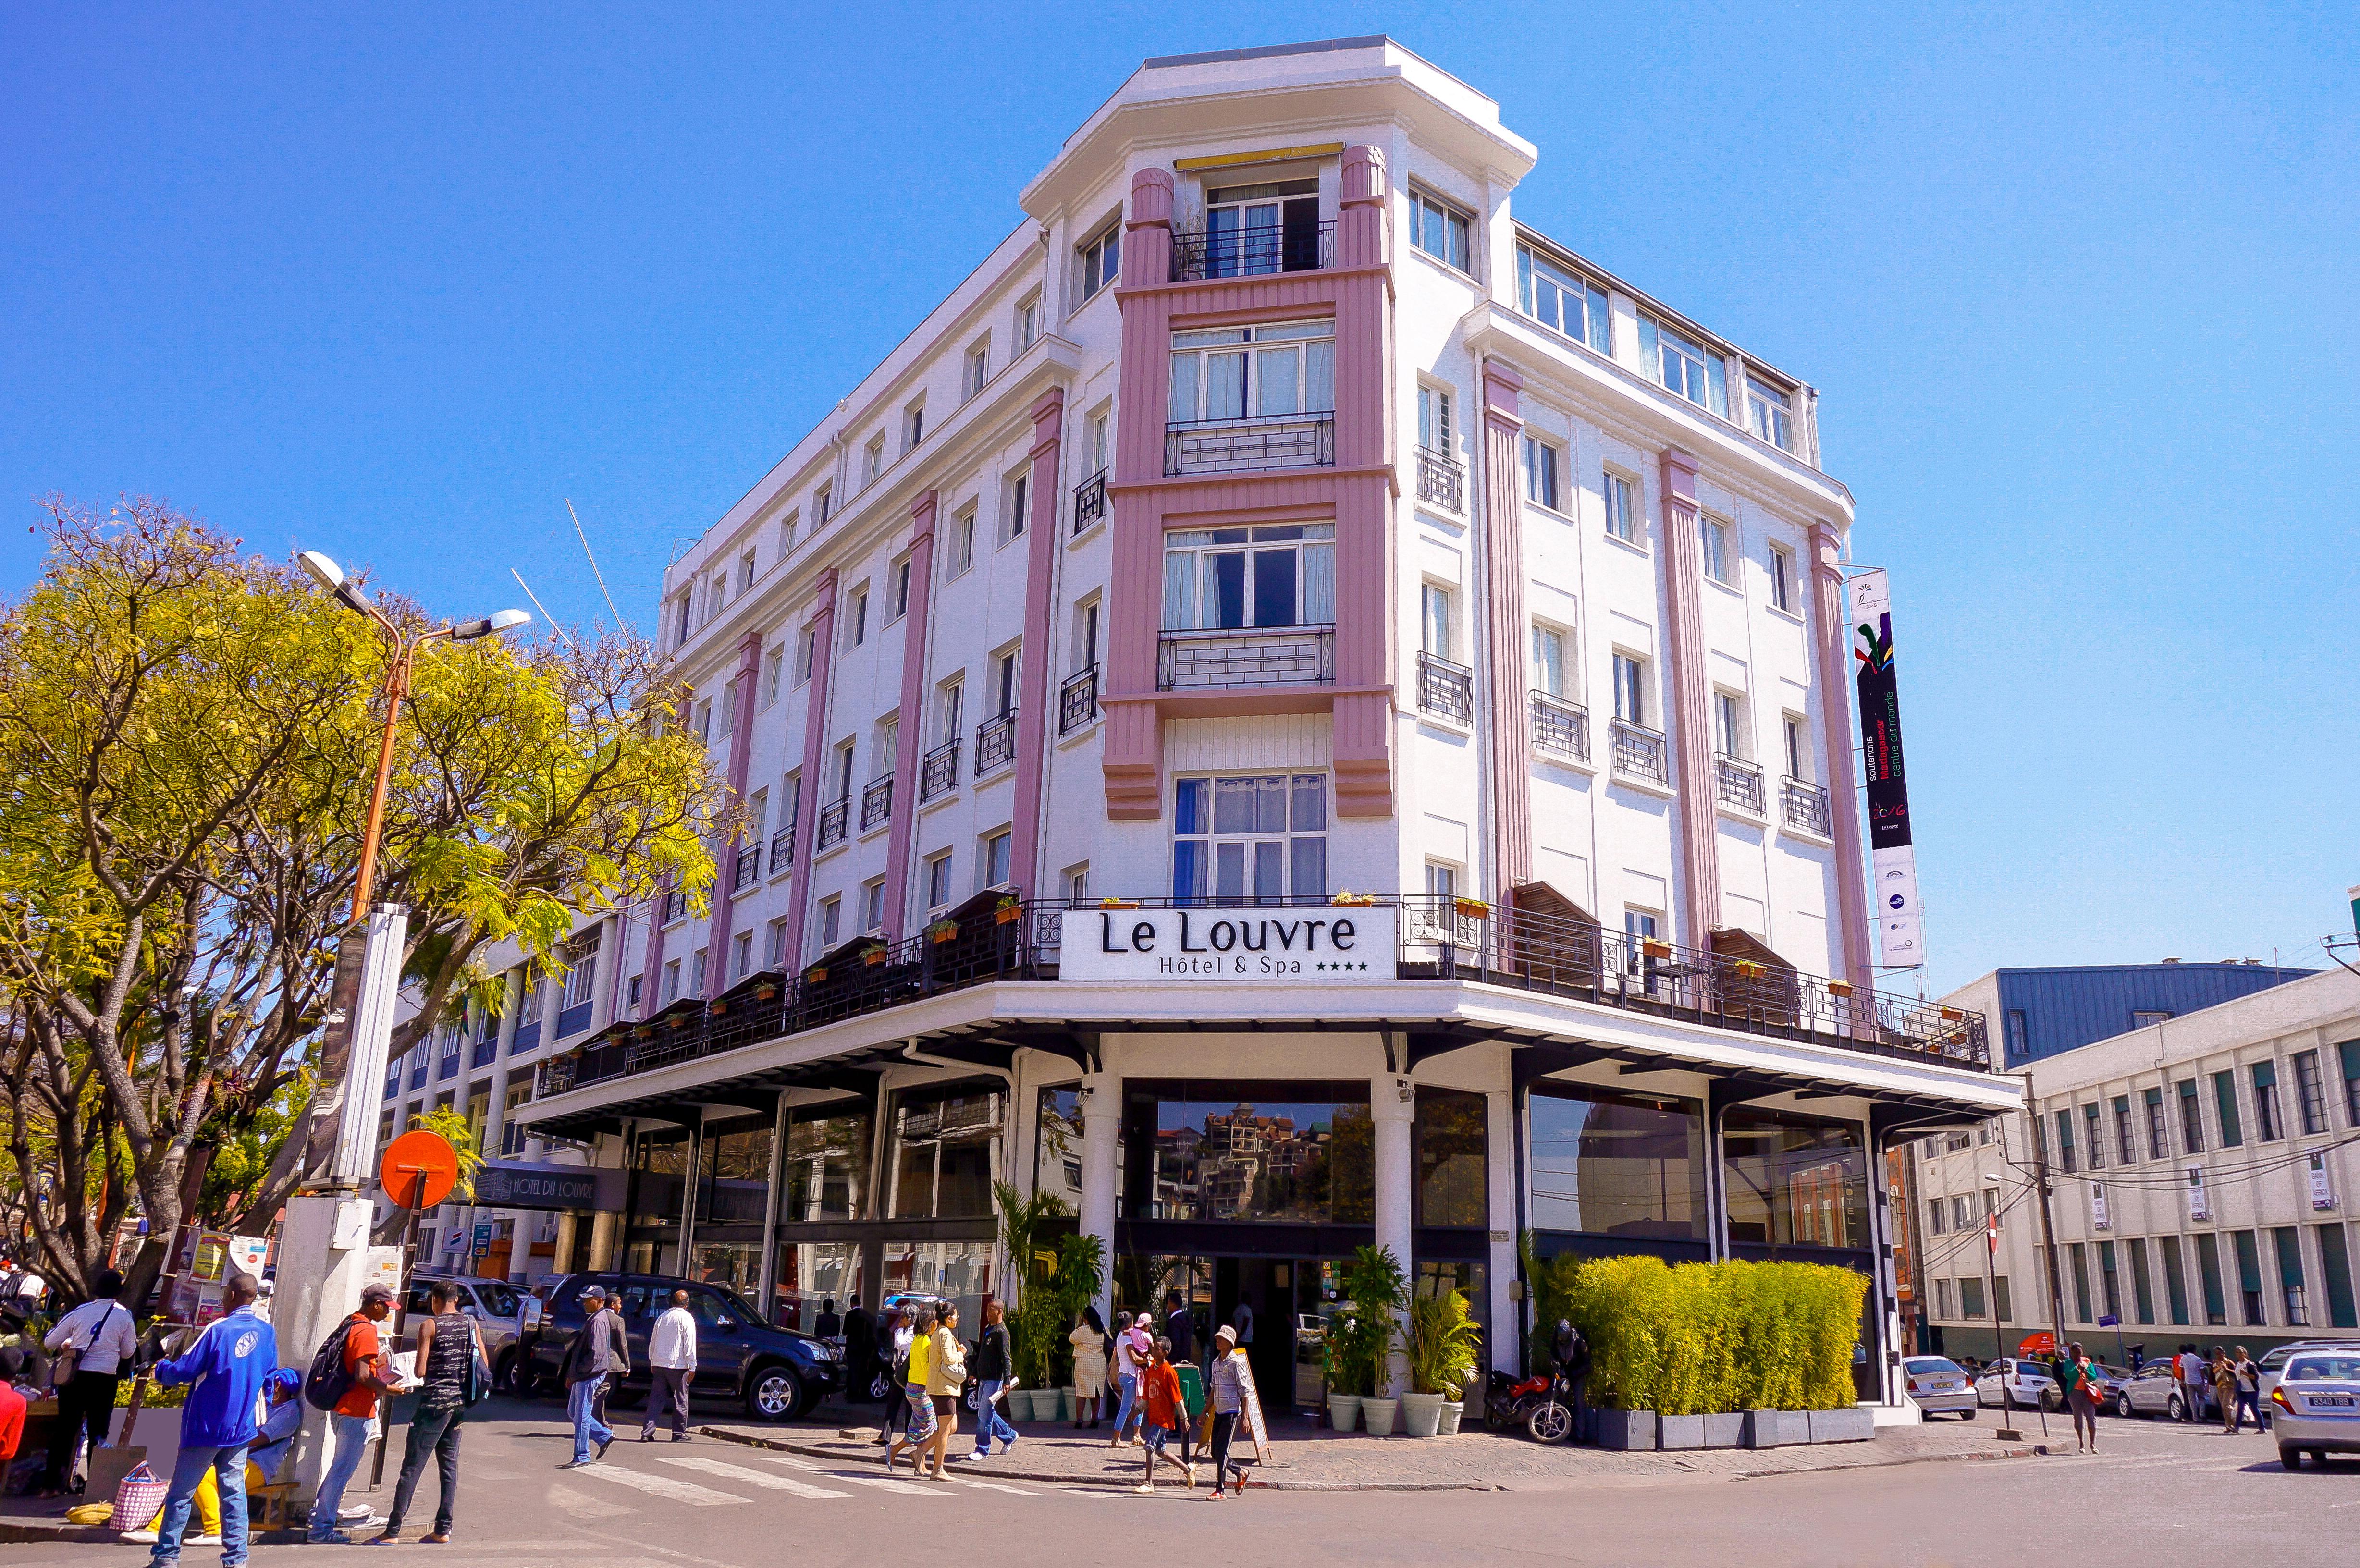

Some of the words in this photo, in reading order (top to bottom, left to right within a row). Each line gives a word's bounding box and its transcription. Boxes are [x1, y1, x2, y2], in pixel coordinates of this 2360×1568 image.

[1885, 691, 1896, 726] monde
[1877, 719, 1889, 780] Madagascar
[1889, 729, 1897, 742] du
[1867, 736, 1877, 781] soutenons
[1891, 745, 1901, 777] centre
[1099, 912, 1155, 952] Le
[1177, 911, 1356, 953] Louvre
[1160, 956, 1222, 974] Hôtel
[1235, 956, 1248, 974] &
[1260, 956, 1301, 978] Spa
[513, 1177, 540, 1195] HOTEL
[542, 1179, 556, 1196] DU
[559, 1181, 593, 1199] LOUVRE
[1845, 1180, 1856, 1225] HOTEL
